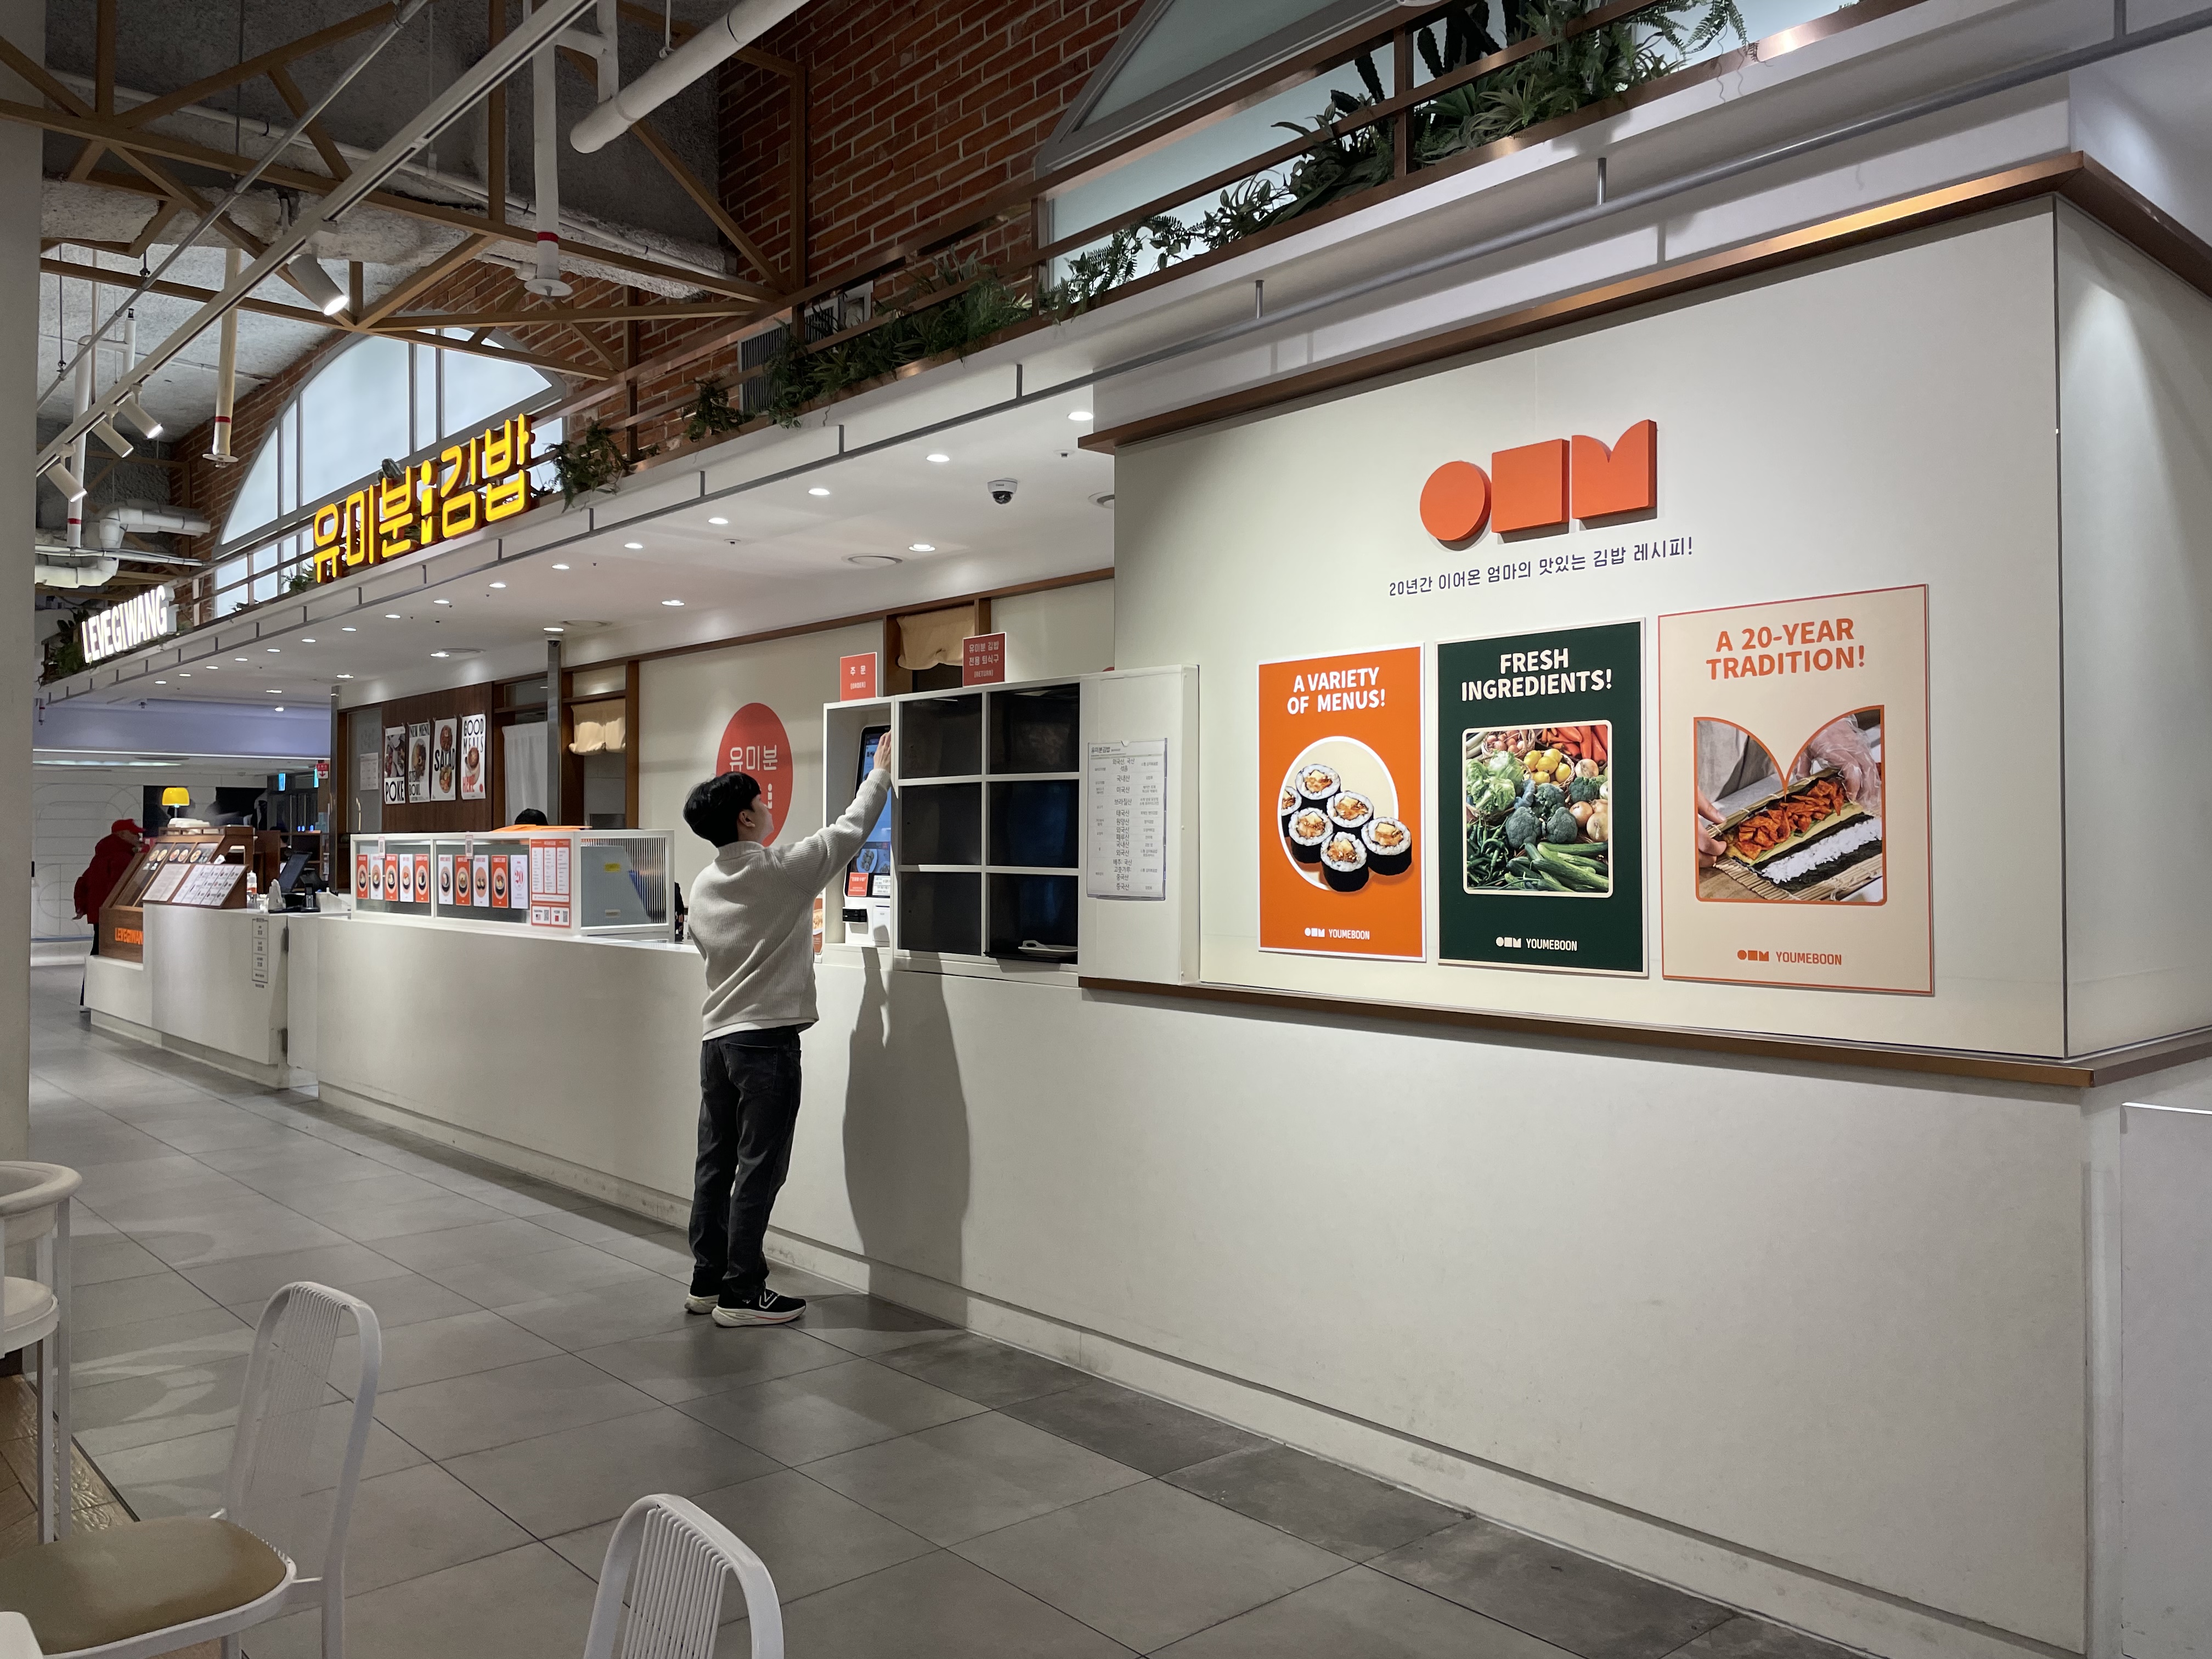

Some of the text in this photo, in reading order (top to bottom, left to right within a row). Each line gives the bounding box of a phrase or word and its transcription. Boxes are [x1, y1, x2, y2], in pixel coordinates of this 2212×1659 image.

[1389, 537, 1694, 597] 20년간 이어온 엄마의 맛있는 김밥 레시피!
[82, 585, 168, 664] LEVEGIWANG
[1716, 618, 1854, 652] A 20-YEAR
[969, 641, 999, 653] 유미분 김밥
[969, 654, 999, 667] 전용 퇴식구
[1500, 647, 1569, 674] FRESH
[1706, 645, 1865, 680] TRADITION!
[1293, 667, 1380, 693] A VARIETY
[1462, 669, 1612, 702] INGREDIENTS!
[1287, 689, 1386, 715] OF MENUS!
[464, 719, 484, 737] GOOD
[729, 744, 778, 772] 유미분
[386, 781, 404, 802] POKE
[115, 927, 144, 945] LEVEGIWAN
[1328, 929, 1370, 940] YOUMEBOON
[1526, 938, 1577, 951] YOUMEBOON
[1776, 951, 1842, 966] YOUMEBOON
